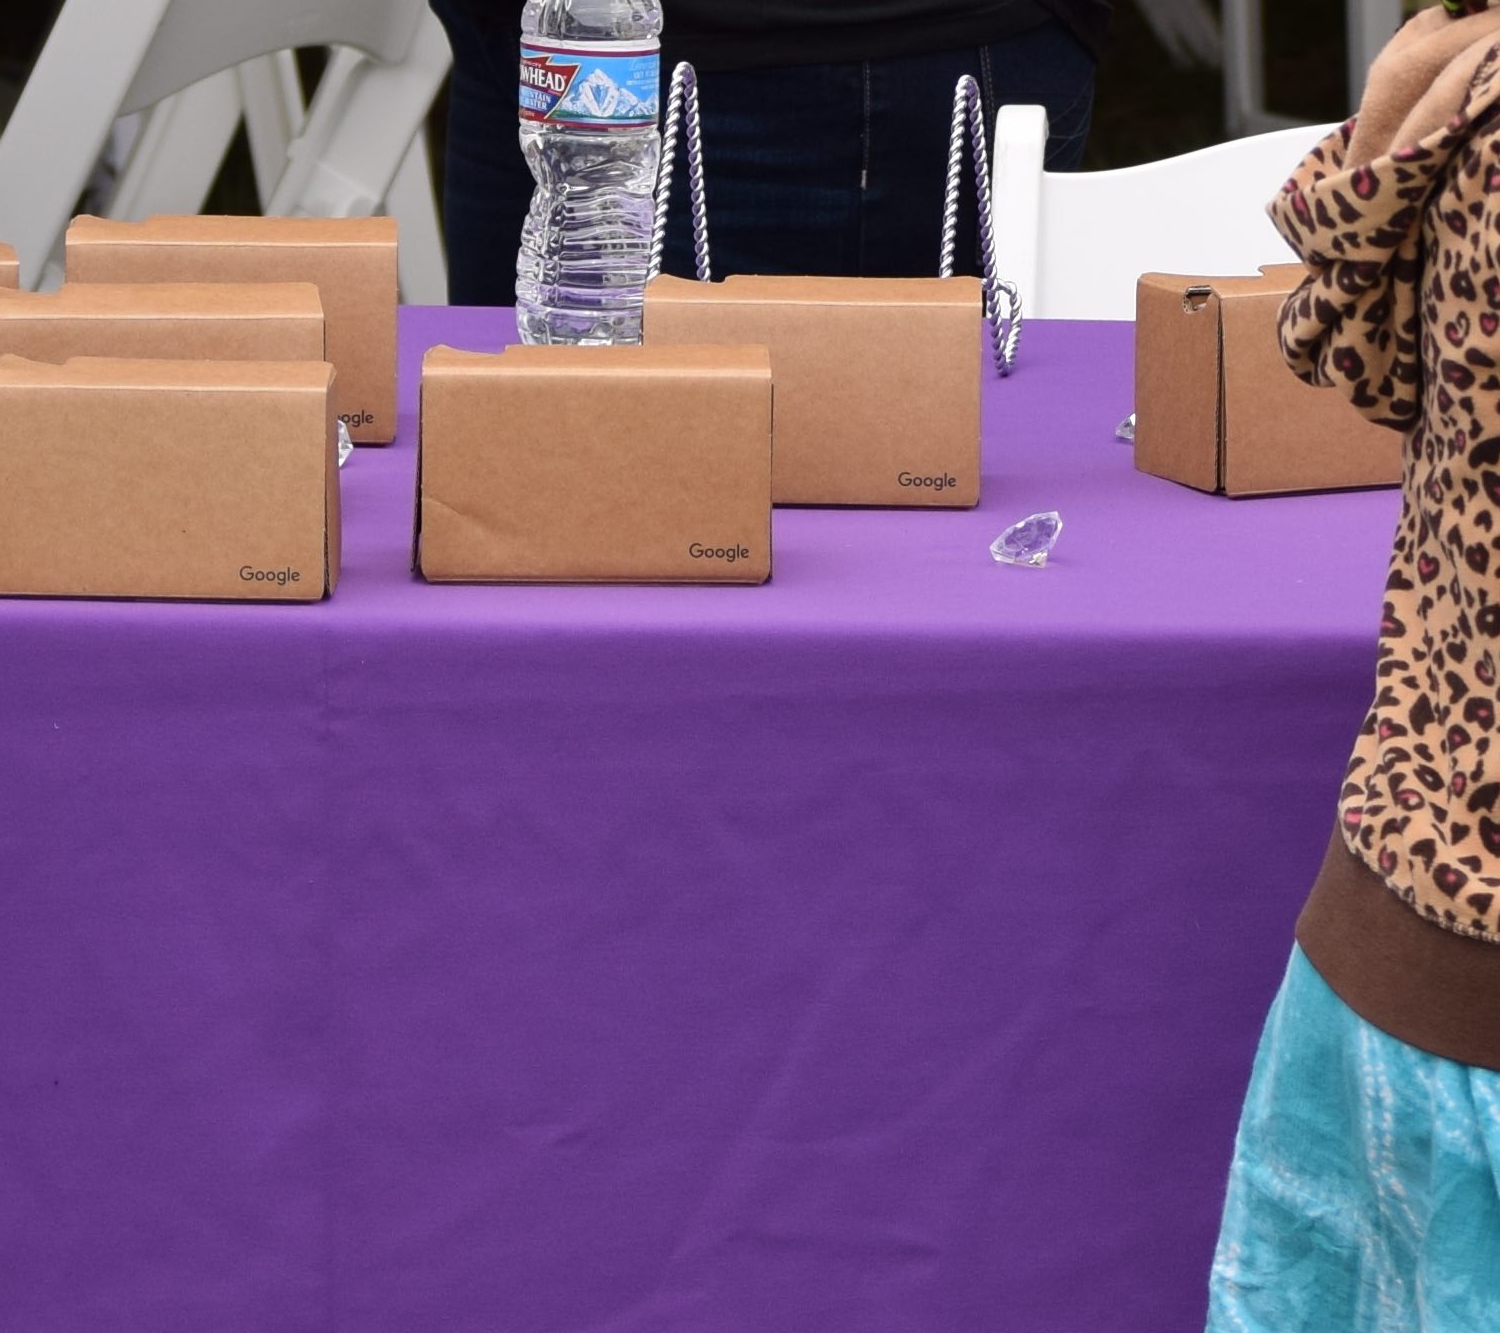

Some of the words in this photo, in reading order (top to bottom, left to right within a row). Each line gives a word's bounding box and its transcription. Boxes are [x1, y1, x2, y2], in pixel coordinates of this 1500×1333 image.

[338, 409, 374, 428] ogle
[897, 471, 956, 491] Google
[689, 542, 749, 563] Google
[239, 565, 300, 585] Google
